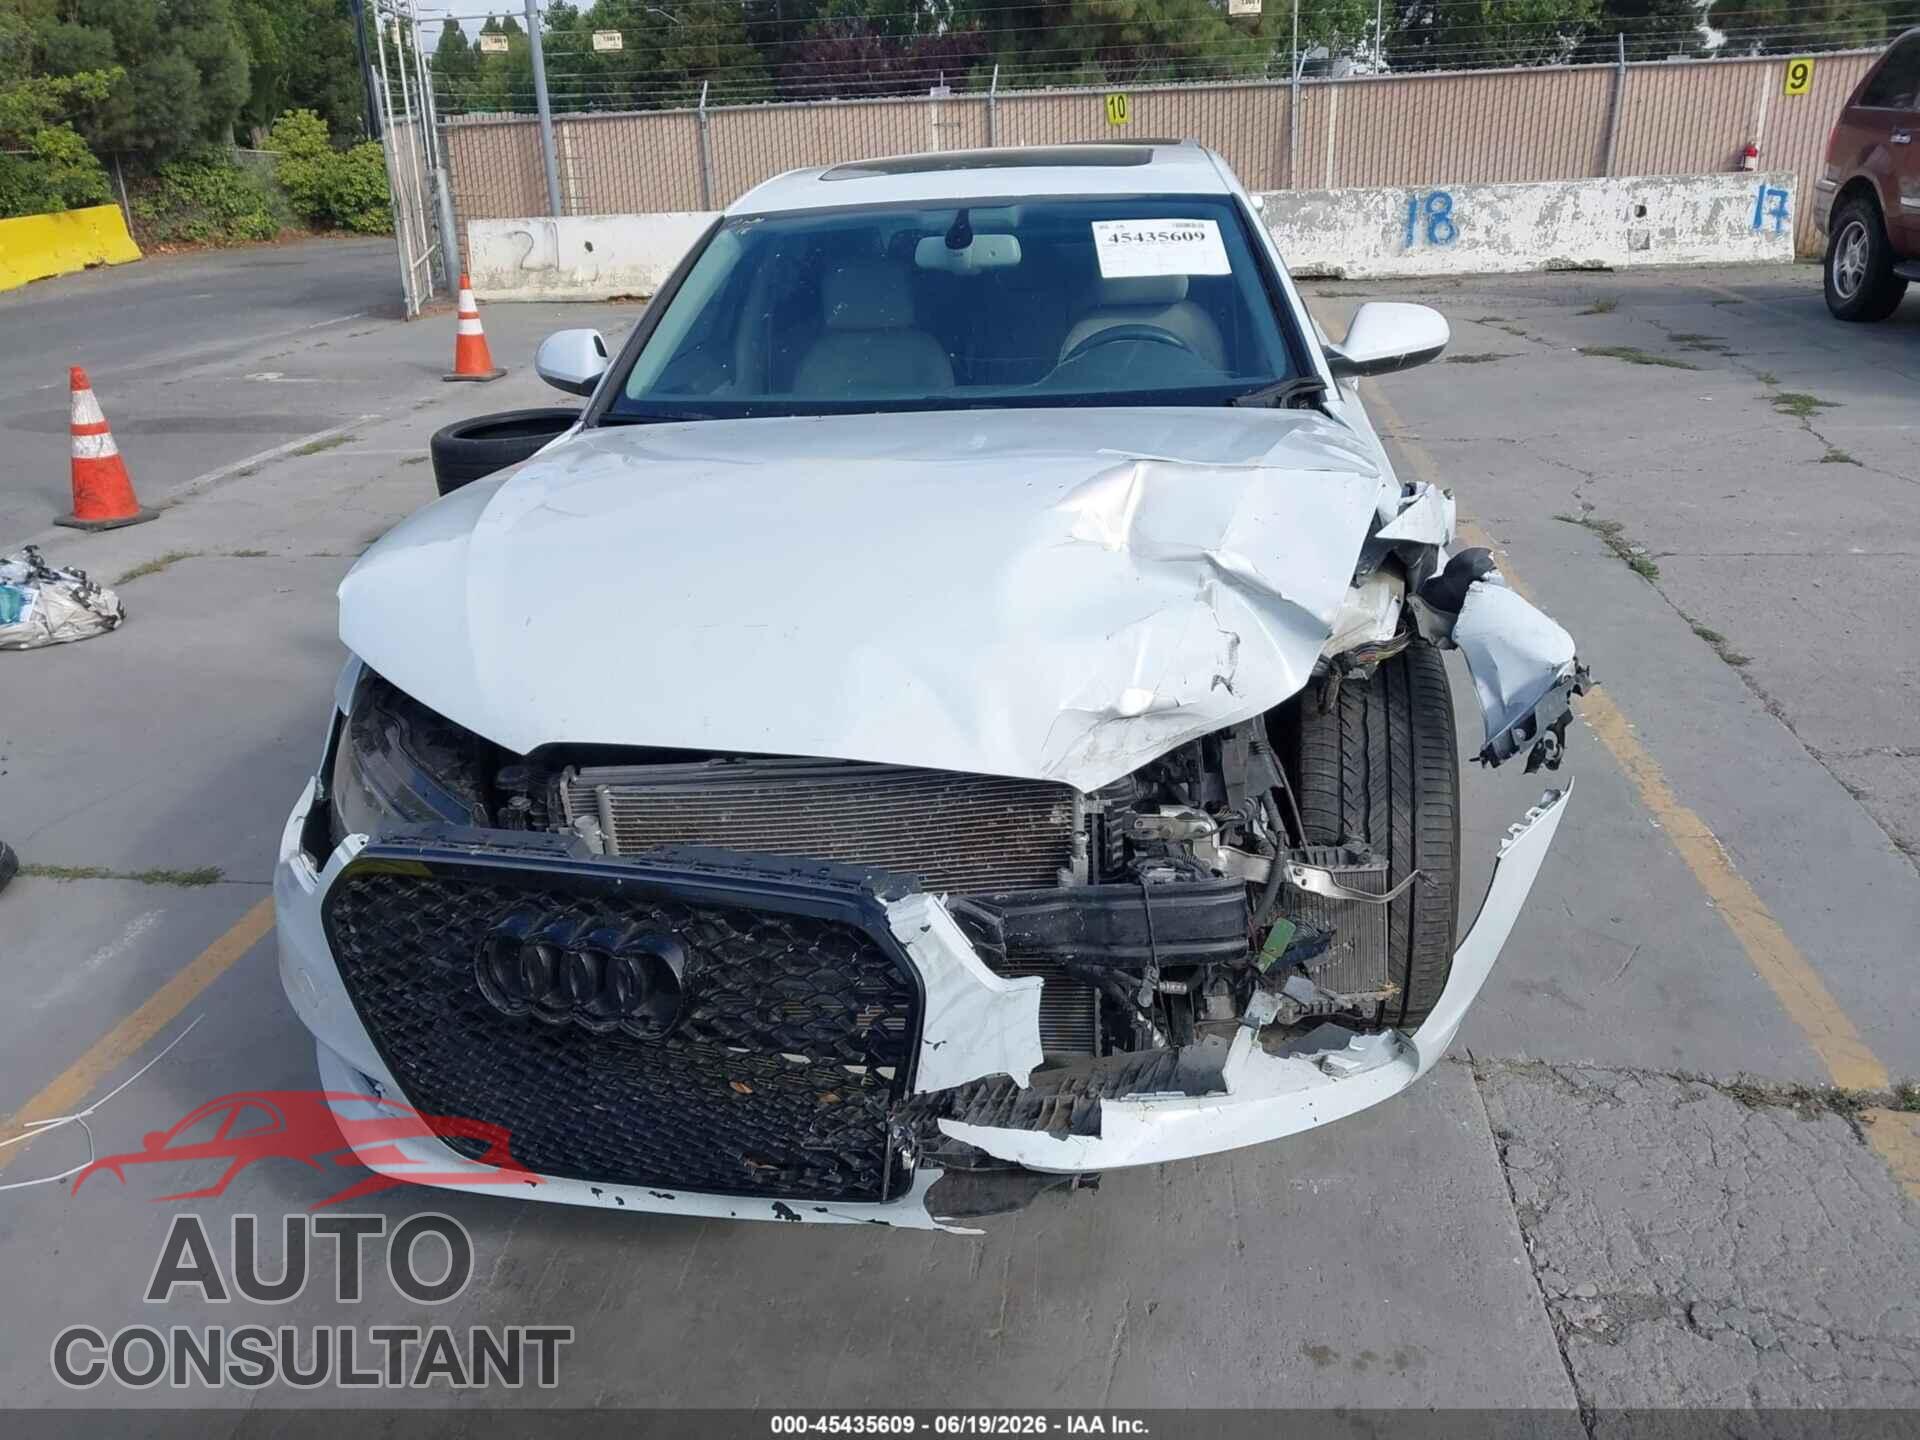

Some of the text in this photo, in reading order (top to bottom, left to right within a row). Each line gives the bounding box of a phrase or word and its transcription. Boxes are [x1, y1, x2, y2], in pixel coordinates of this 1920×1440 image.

[1790, 63, 1808, 89] 9
[1109, 94, 1126, 120] 10
[1405, 191, 1457, 248] 18
[1752, 183, 1789, 233] 17
[1108, 231, 1206, 243] 45435609
